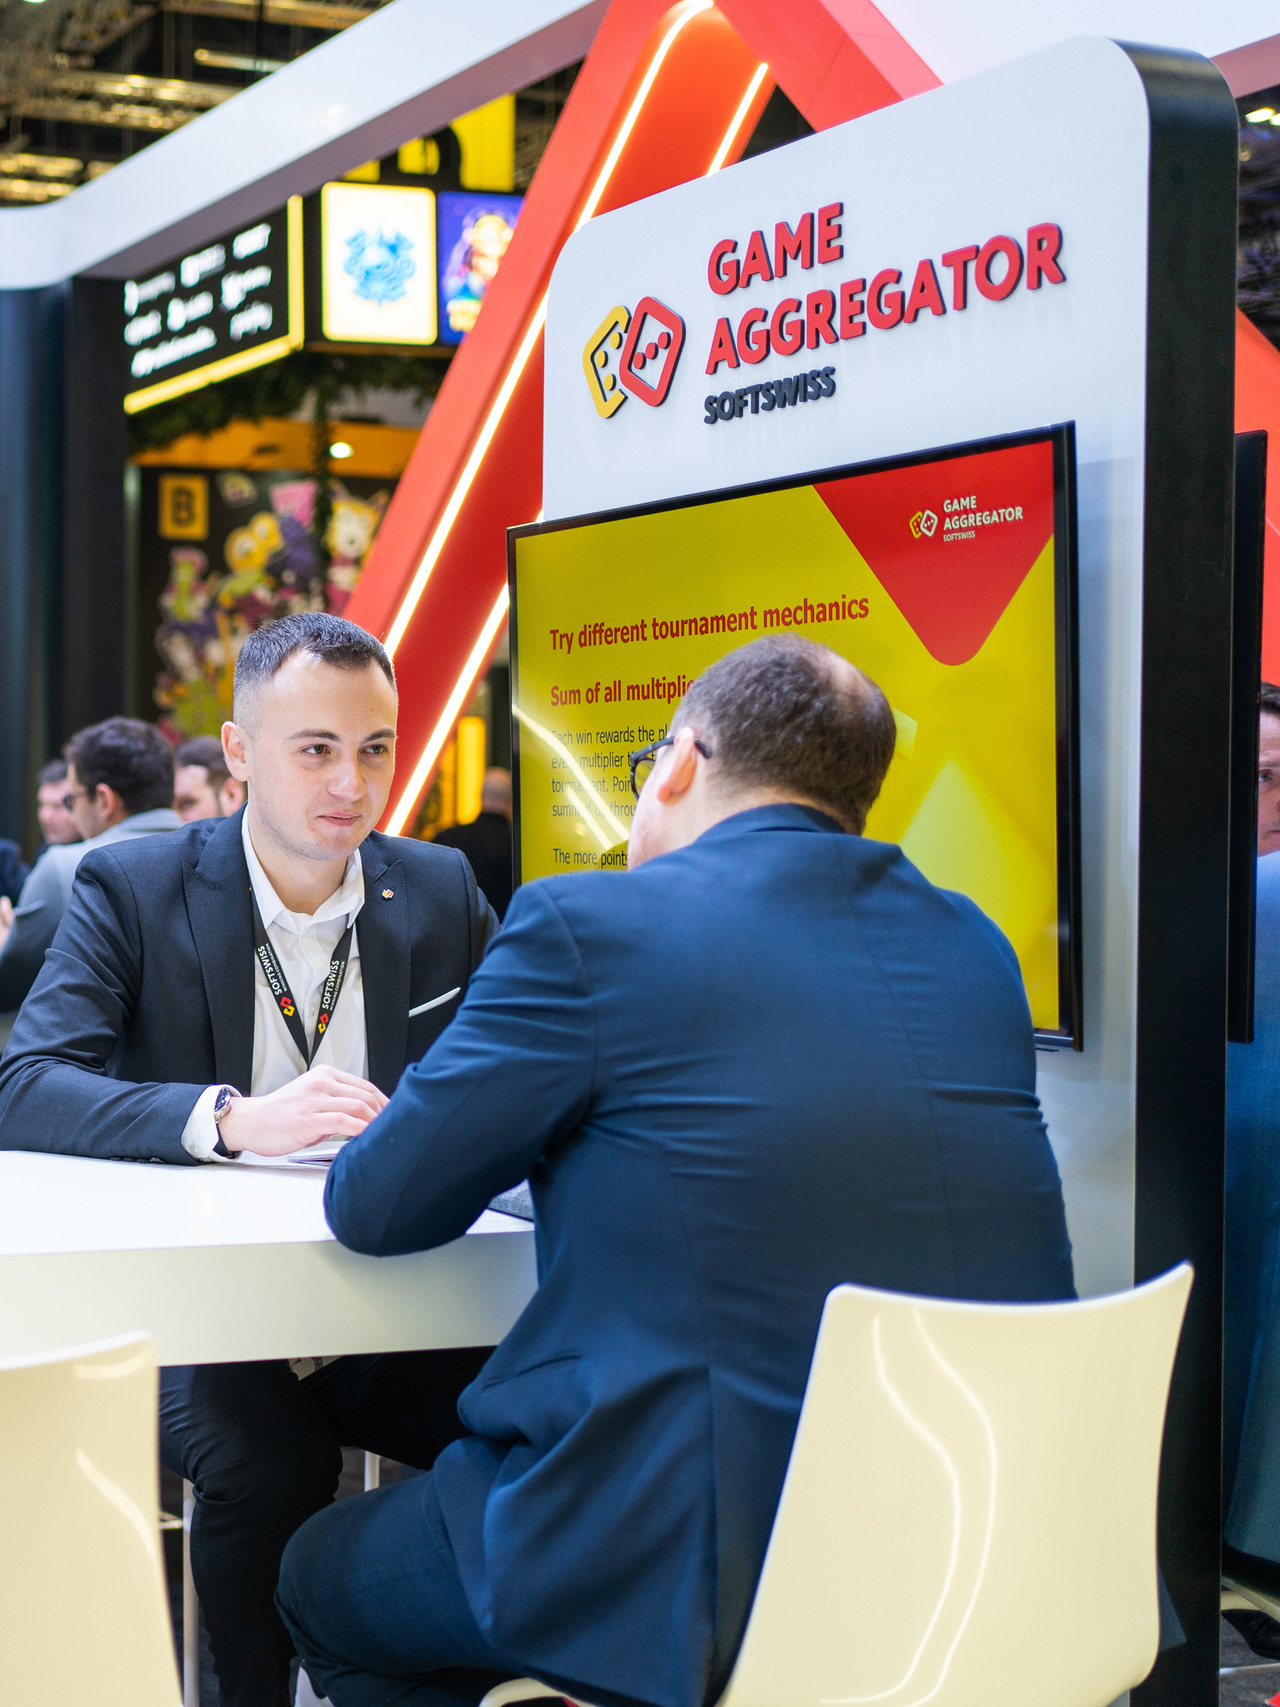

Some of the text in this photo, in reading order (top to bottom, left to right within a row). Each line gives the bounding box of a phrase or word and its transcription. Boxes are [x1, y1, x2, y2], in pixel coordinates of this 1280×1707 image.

[707, 201, 843, 295] GAME
[705, 222, 1067, 375] AGGREGATOR
[704, 366, 837, 425] SOFTSWISS
[943, 495, 977, 513] GAME
[943, 506, 1024, 530] AGGREGATOR
[942, 530, 976, 542] SOFTSWISS
[549, 594, 869, 654] Try different tournament mechanics
[550, 685, 581, 707] Sum
[585, 681, 601, 704] of
[604, 680, 621, 703] all
[576, 729, 593, 744] win
[596, 726, 635, 744] rewards
[638, 725, 655, 742] the
[580, 751, 624, 772] multiplier
[553, 848, 571, 865] The
[573, 852, 597, 866] more
[258, 945, 282, 995] SOFTSWISS
[322, 960, 340, 1009] SOFTSWISS
